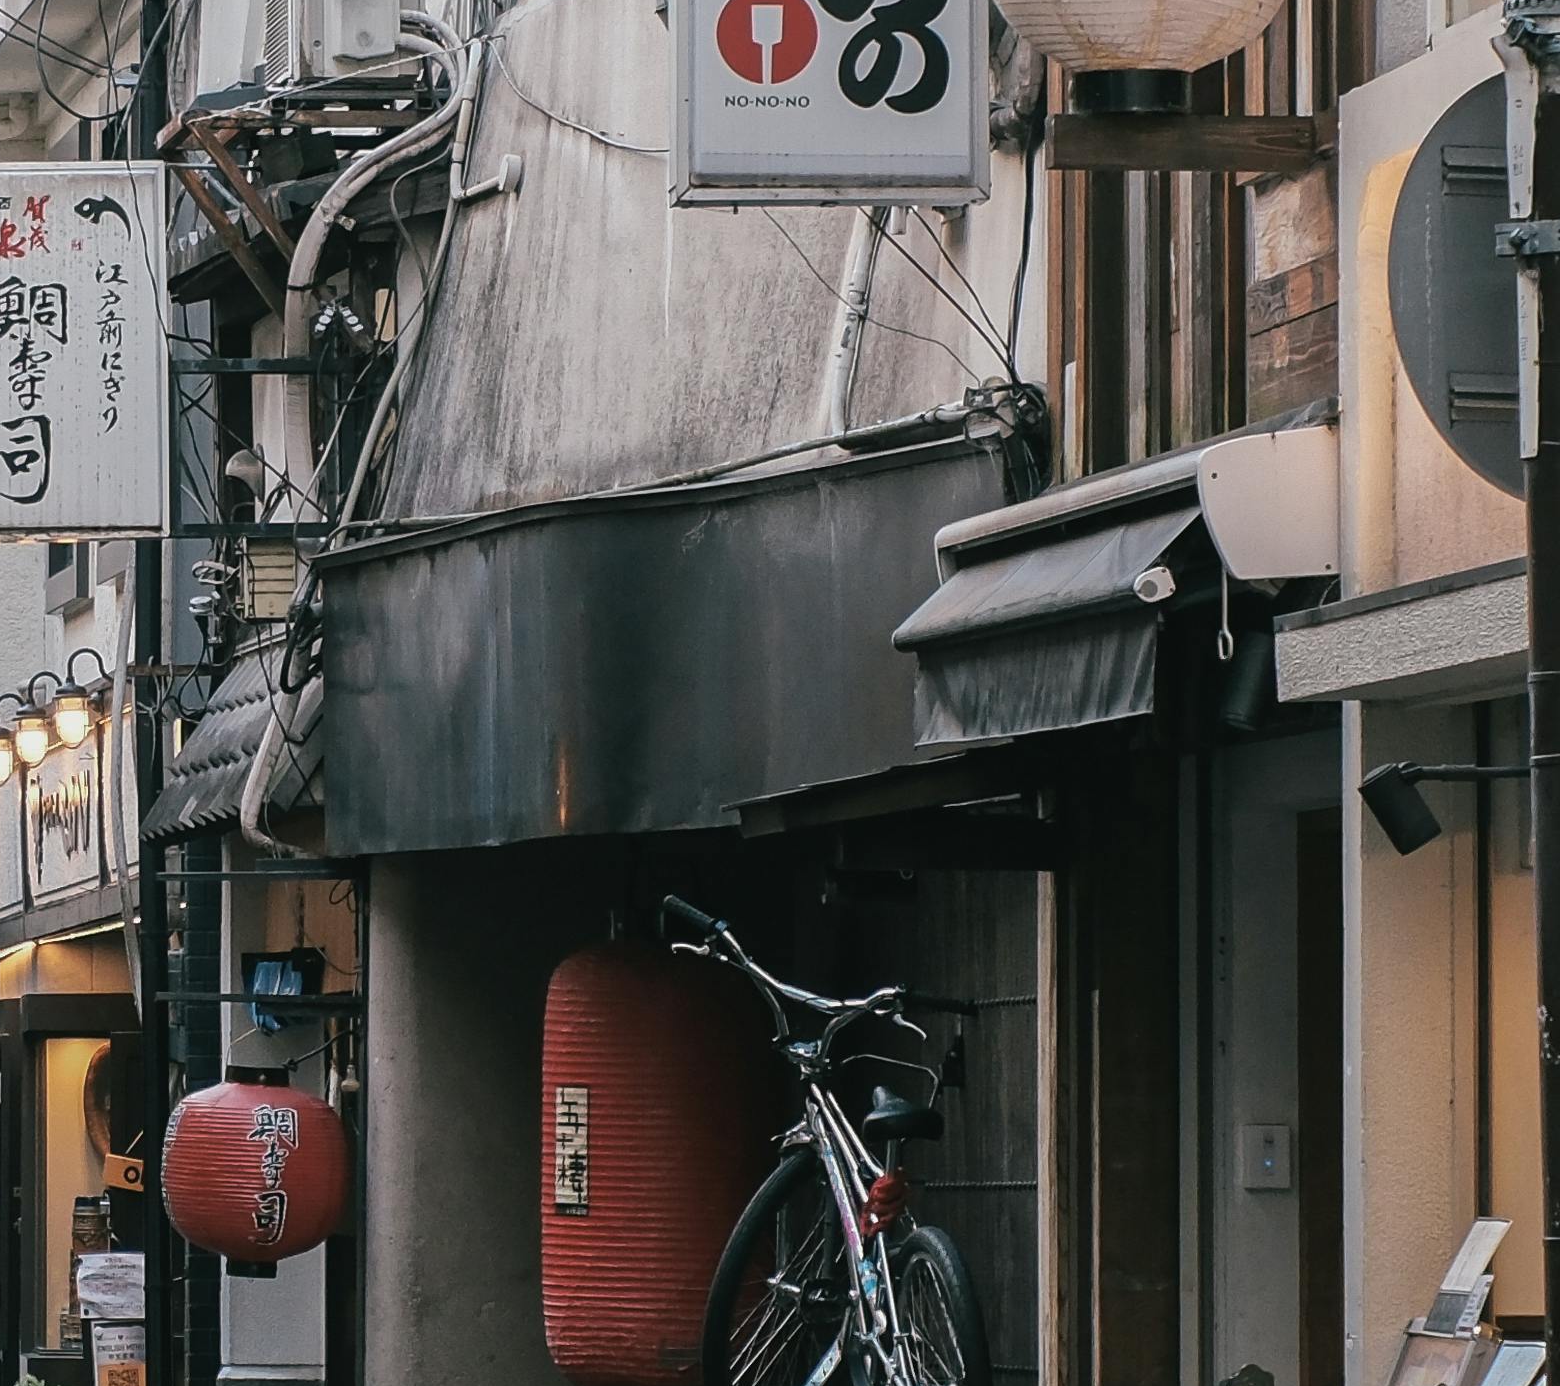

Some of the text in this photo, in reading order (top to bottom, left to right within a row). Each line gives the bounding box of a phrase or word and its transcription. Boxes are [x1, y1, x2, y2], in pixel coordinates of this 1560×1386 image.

[724, 95, 811, 109] NO-NO-NO
[95, 259, 129, 433] 江戸前にぎり
